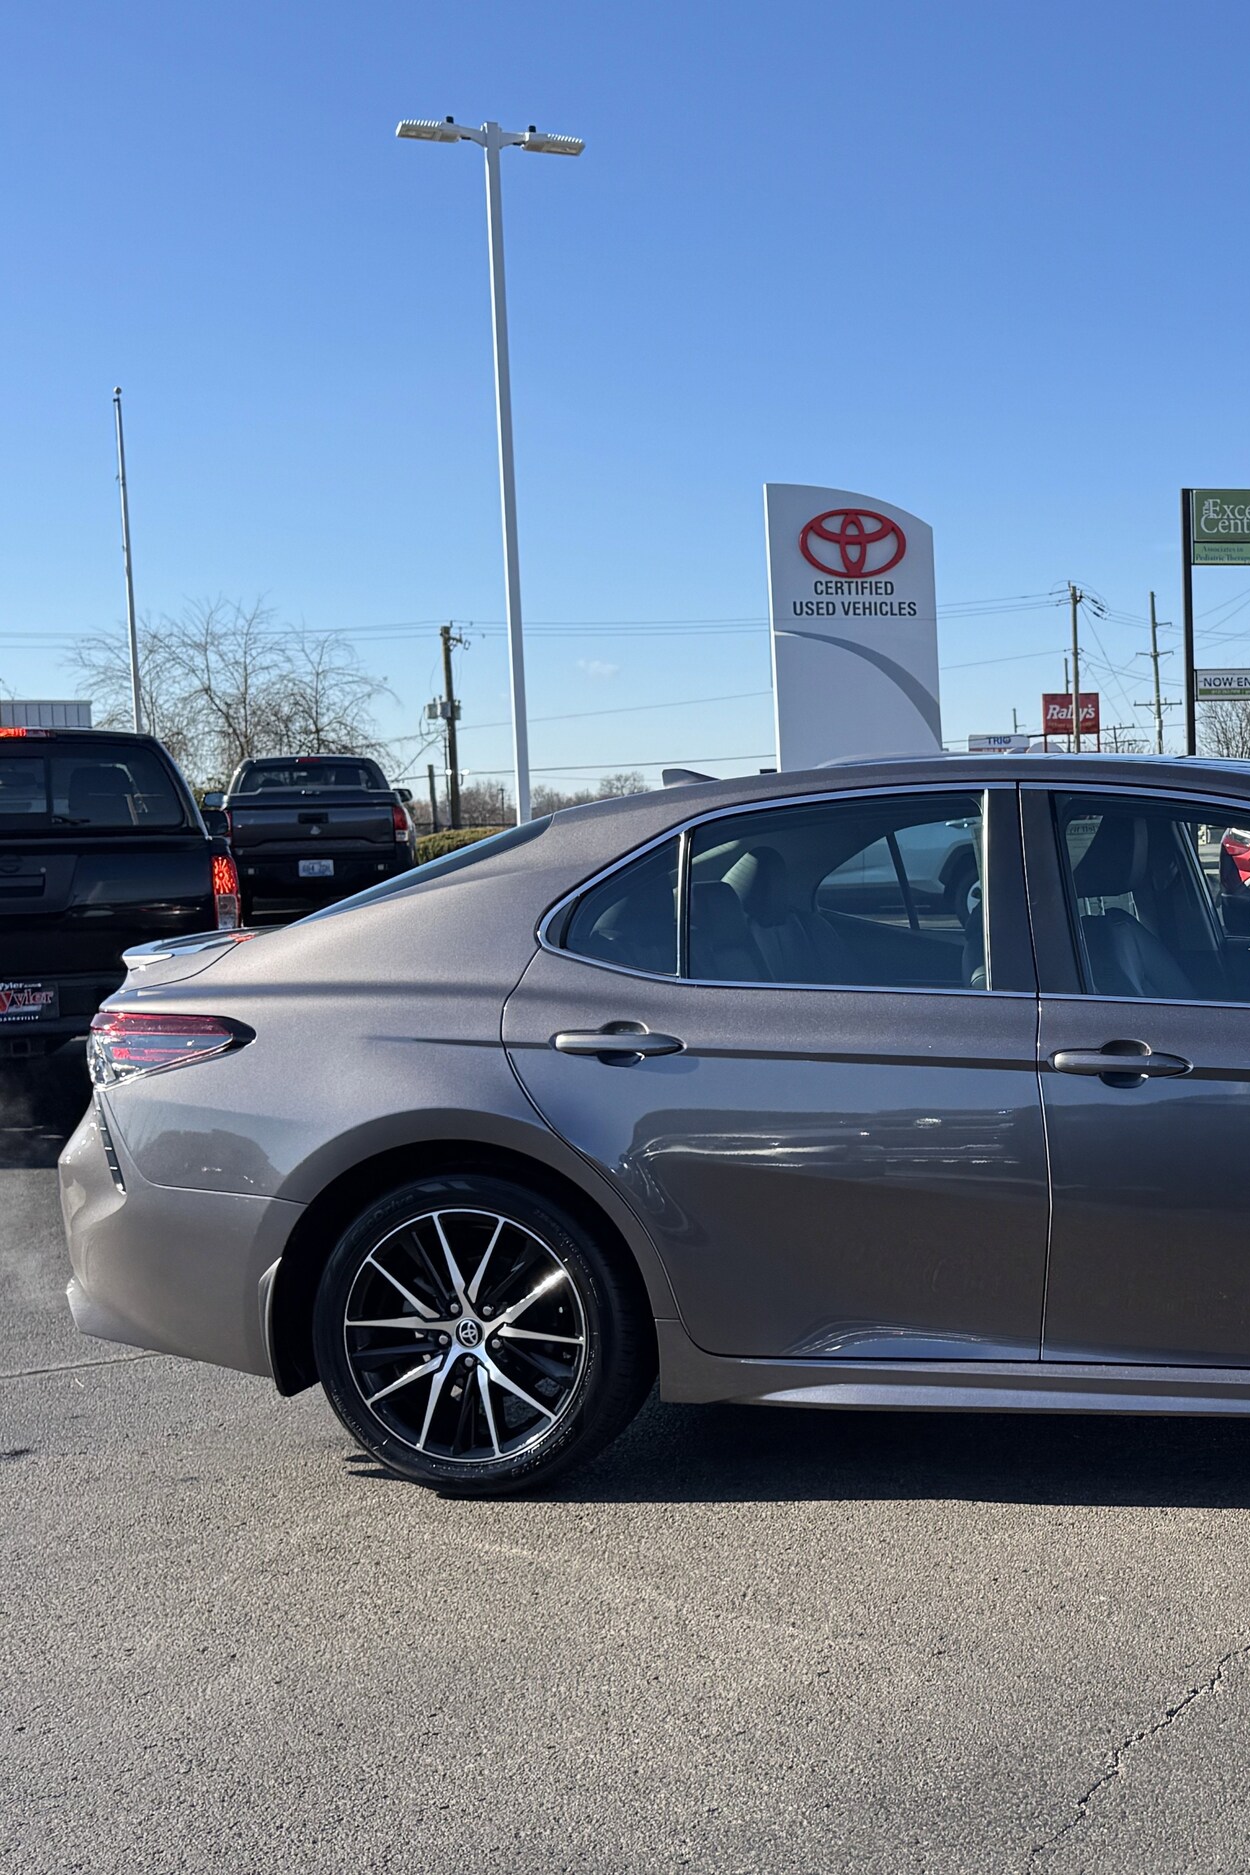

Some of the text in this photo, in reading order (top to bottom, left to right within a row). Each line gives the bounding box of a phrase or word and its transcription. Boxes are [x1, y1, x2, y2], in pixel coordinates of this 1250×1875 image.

[814, 580, 894, 596] CERTIFIED
[793, 601, 917, 617] USED VEHICLES
[1203, 677, 1234, 687] NOW
[1046, 704, 1096, 722] Raly's
